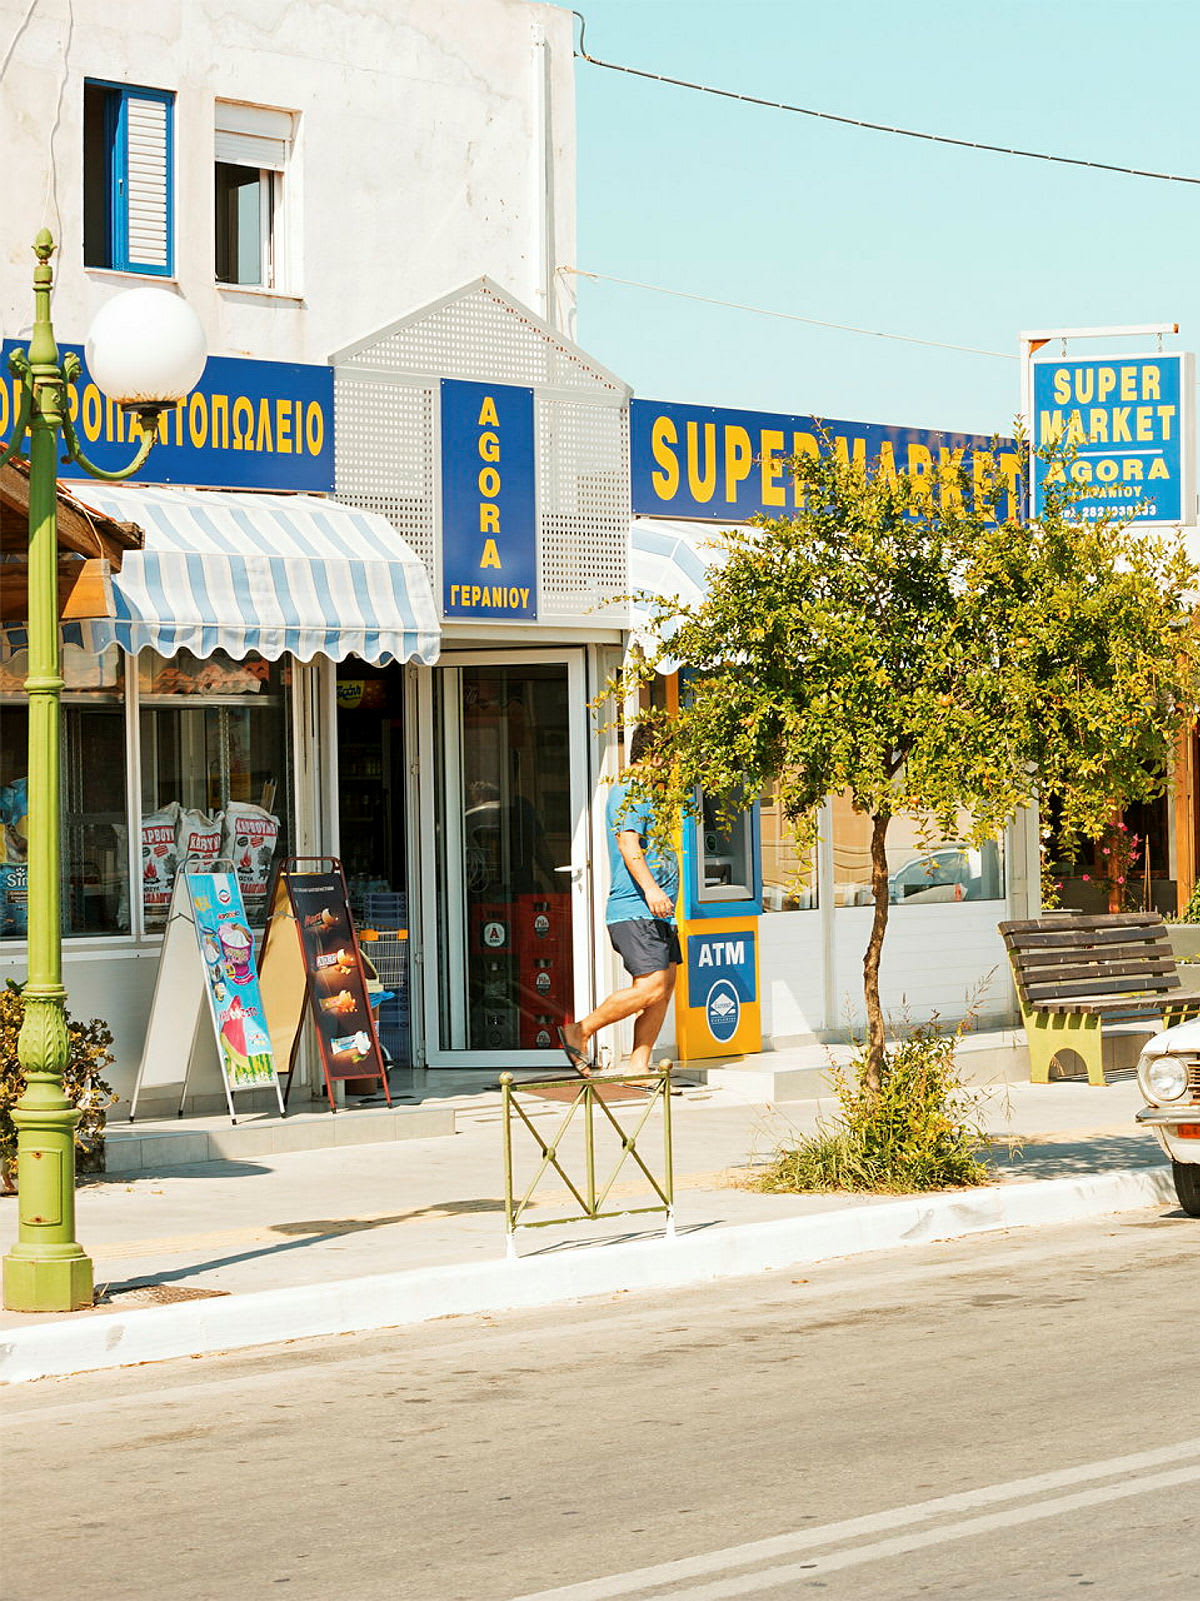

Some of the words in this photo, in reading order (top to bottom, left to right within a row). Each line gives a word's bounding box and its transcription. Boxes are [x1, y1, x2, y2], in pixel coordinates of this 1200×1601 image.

[1053, 365, 1161, 405] SUPER
[1040, 405, 1176, 447] MARKET
[478, 396, 502, 569] AGORA
[1044, 458, 1170, 483] AGORA
[451, 585, 530, 608] ΓΕΡΑΝΙΟΥ
[698, 941, 745, 969] ATM
